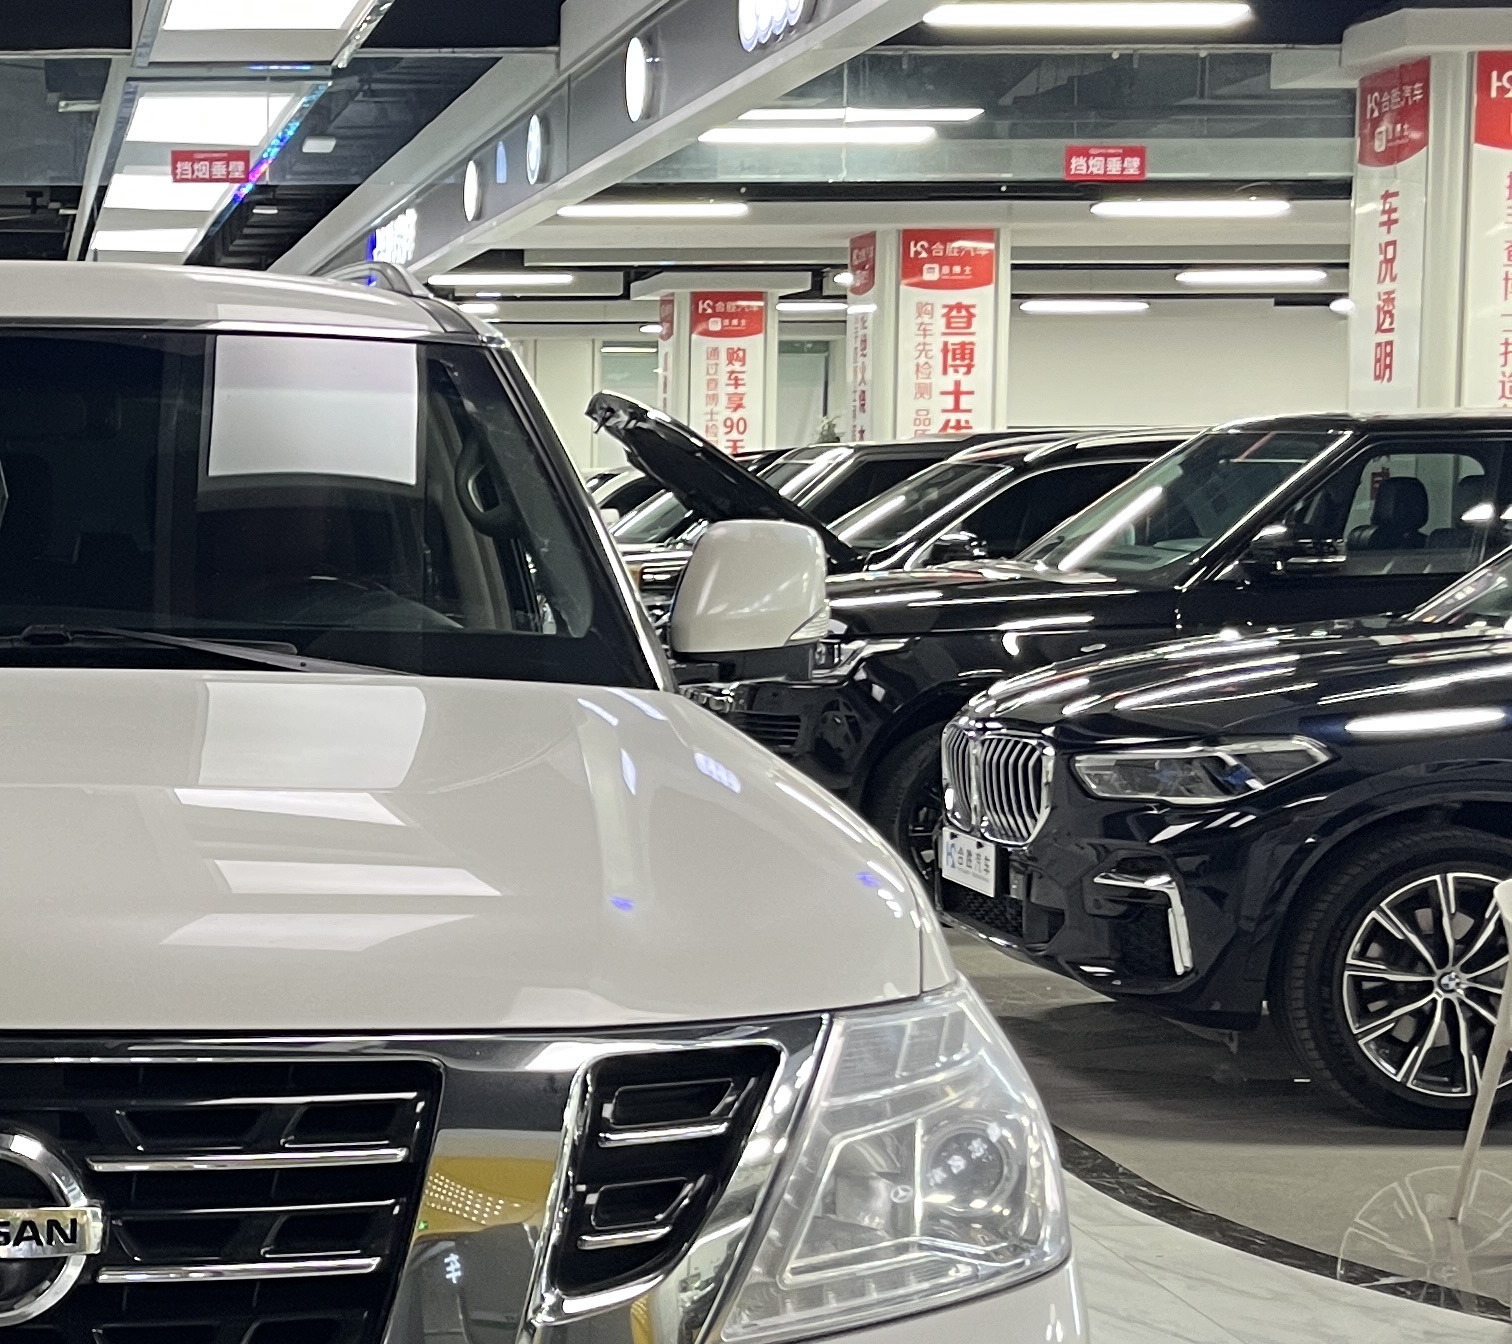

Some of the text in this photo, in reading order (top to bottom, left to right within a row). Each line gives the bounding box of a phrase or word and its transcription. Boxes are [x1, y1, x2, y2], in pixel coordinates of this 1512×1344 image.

[176, 160, 246, 180] 挡烟垂壁
[1070, 155, 1140, 175] 挡烟垂壁
[1373, 189, 1400, 384] 车况透明
[913, 301, 934, 400] 购车先检测
